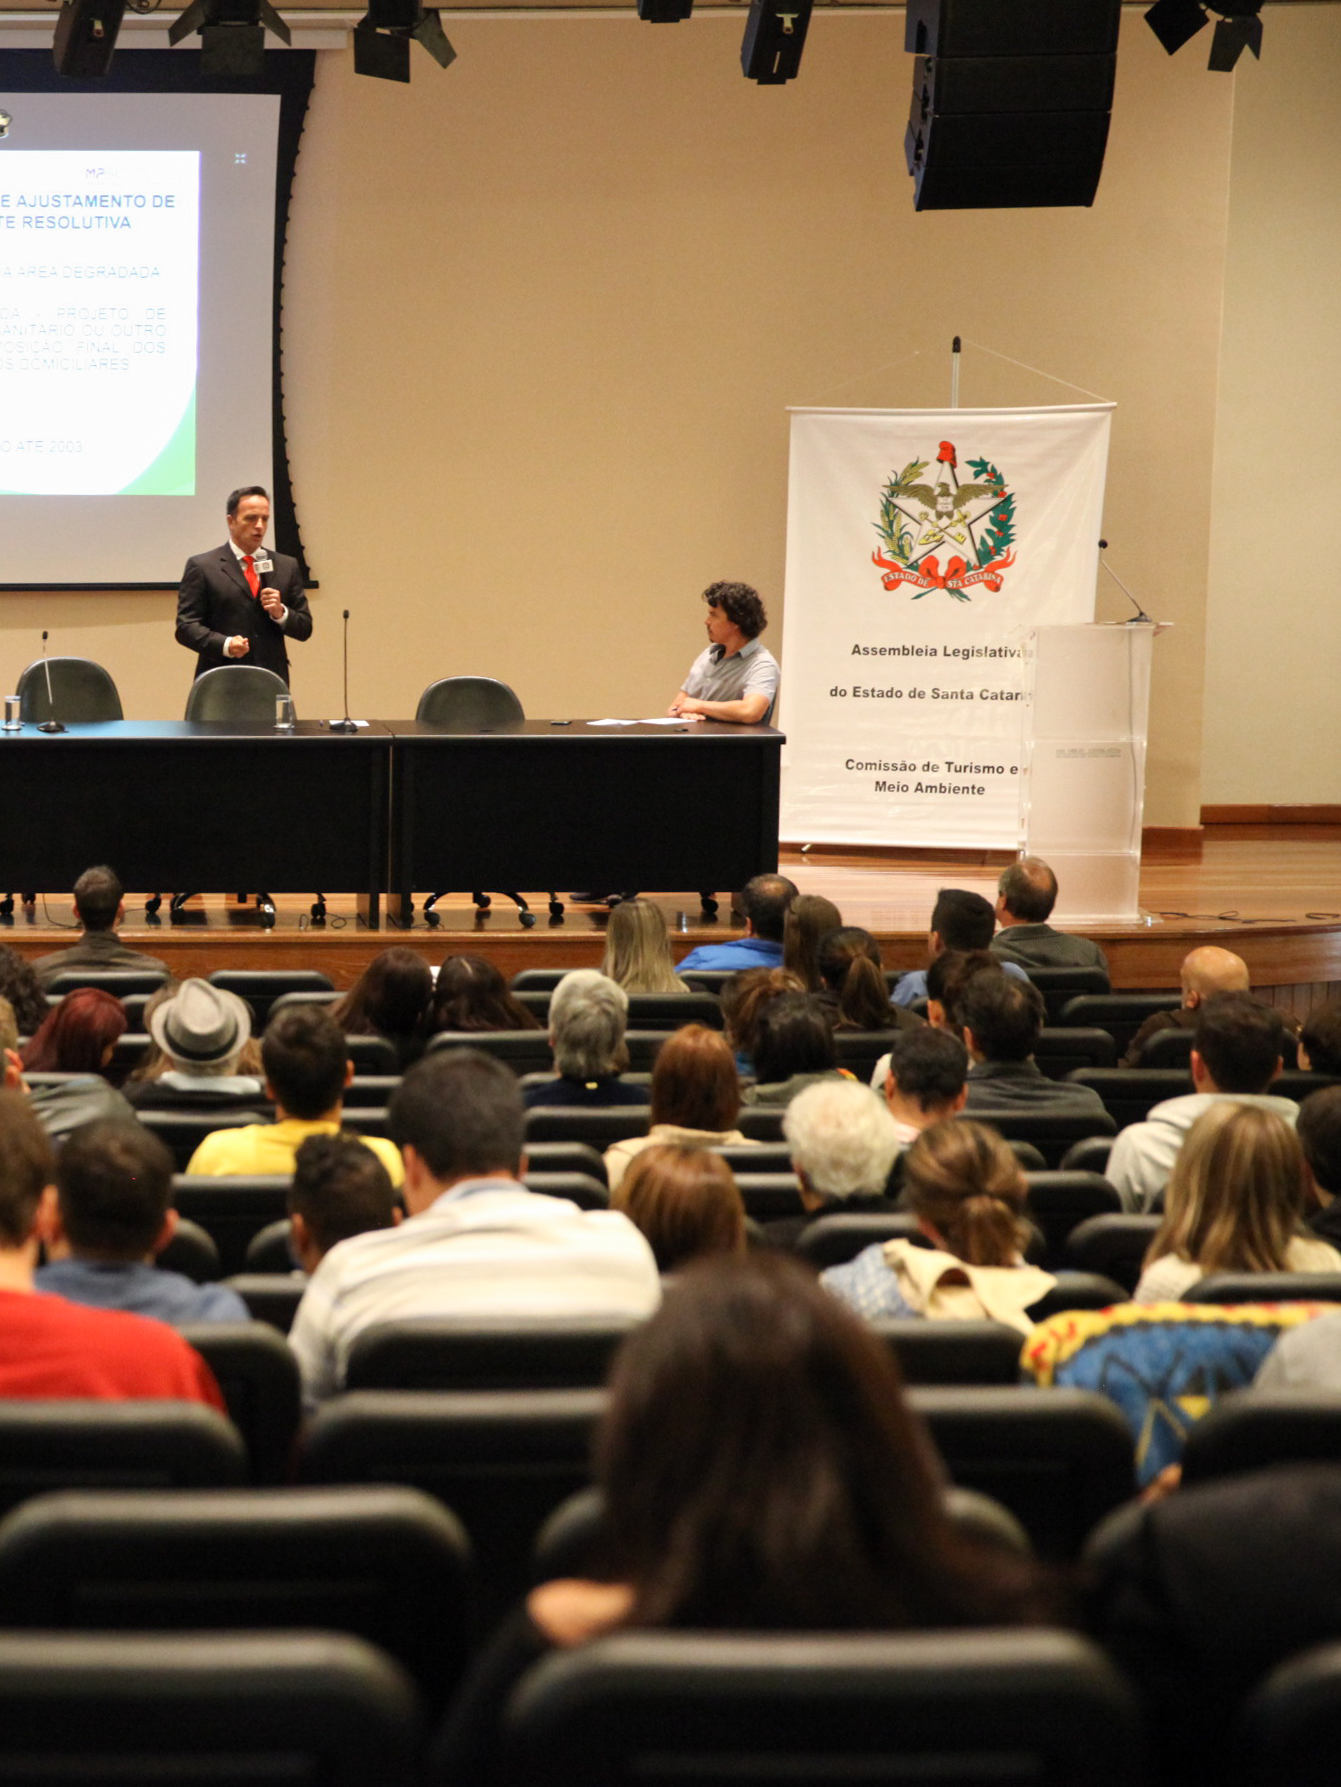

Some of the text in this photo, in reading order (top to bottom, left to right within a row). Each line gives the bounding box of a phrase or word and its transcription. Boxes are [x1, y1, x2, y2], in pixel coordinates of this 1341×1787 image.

[16, 194, 147, 209] AJUSTAMENTO
[152, 194, 176, 209] DE
[22, 215, 133, 229] RESOLUTIVA
[62, 265, 162, 279] DEGRADADA
[56, 307, 130, 320] PROJETO
[145, 307, 167, 320] DE
[81, 323, 104, 337] OU
[110, 324, 167, 337] OUTRO
[76, 341, 121, 355] FINAL
[132, 341, 167, 355] DOS
[19, 357, 131, 371] DOMICILIARES
[49, 440, 84, 454] 2003
[883, 571, 930, 587] ESTADO DE
[850, 643, 939, 658] Assembleia
[829, 685, 848, 699] do
[852, 686, 904, 700] Estado
[907, 687, 927, 701] de
[930, 688, 975, 701] Santa
[844, 758, 1020, 776] Comissão de Turismo e
[873, 780, 987, 797] Meio Ambiente
